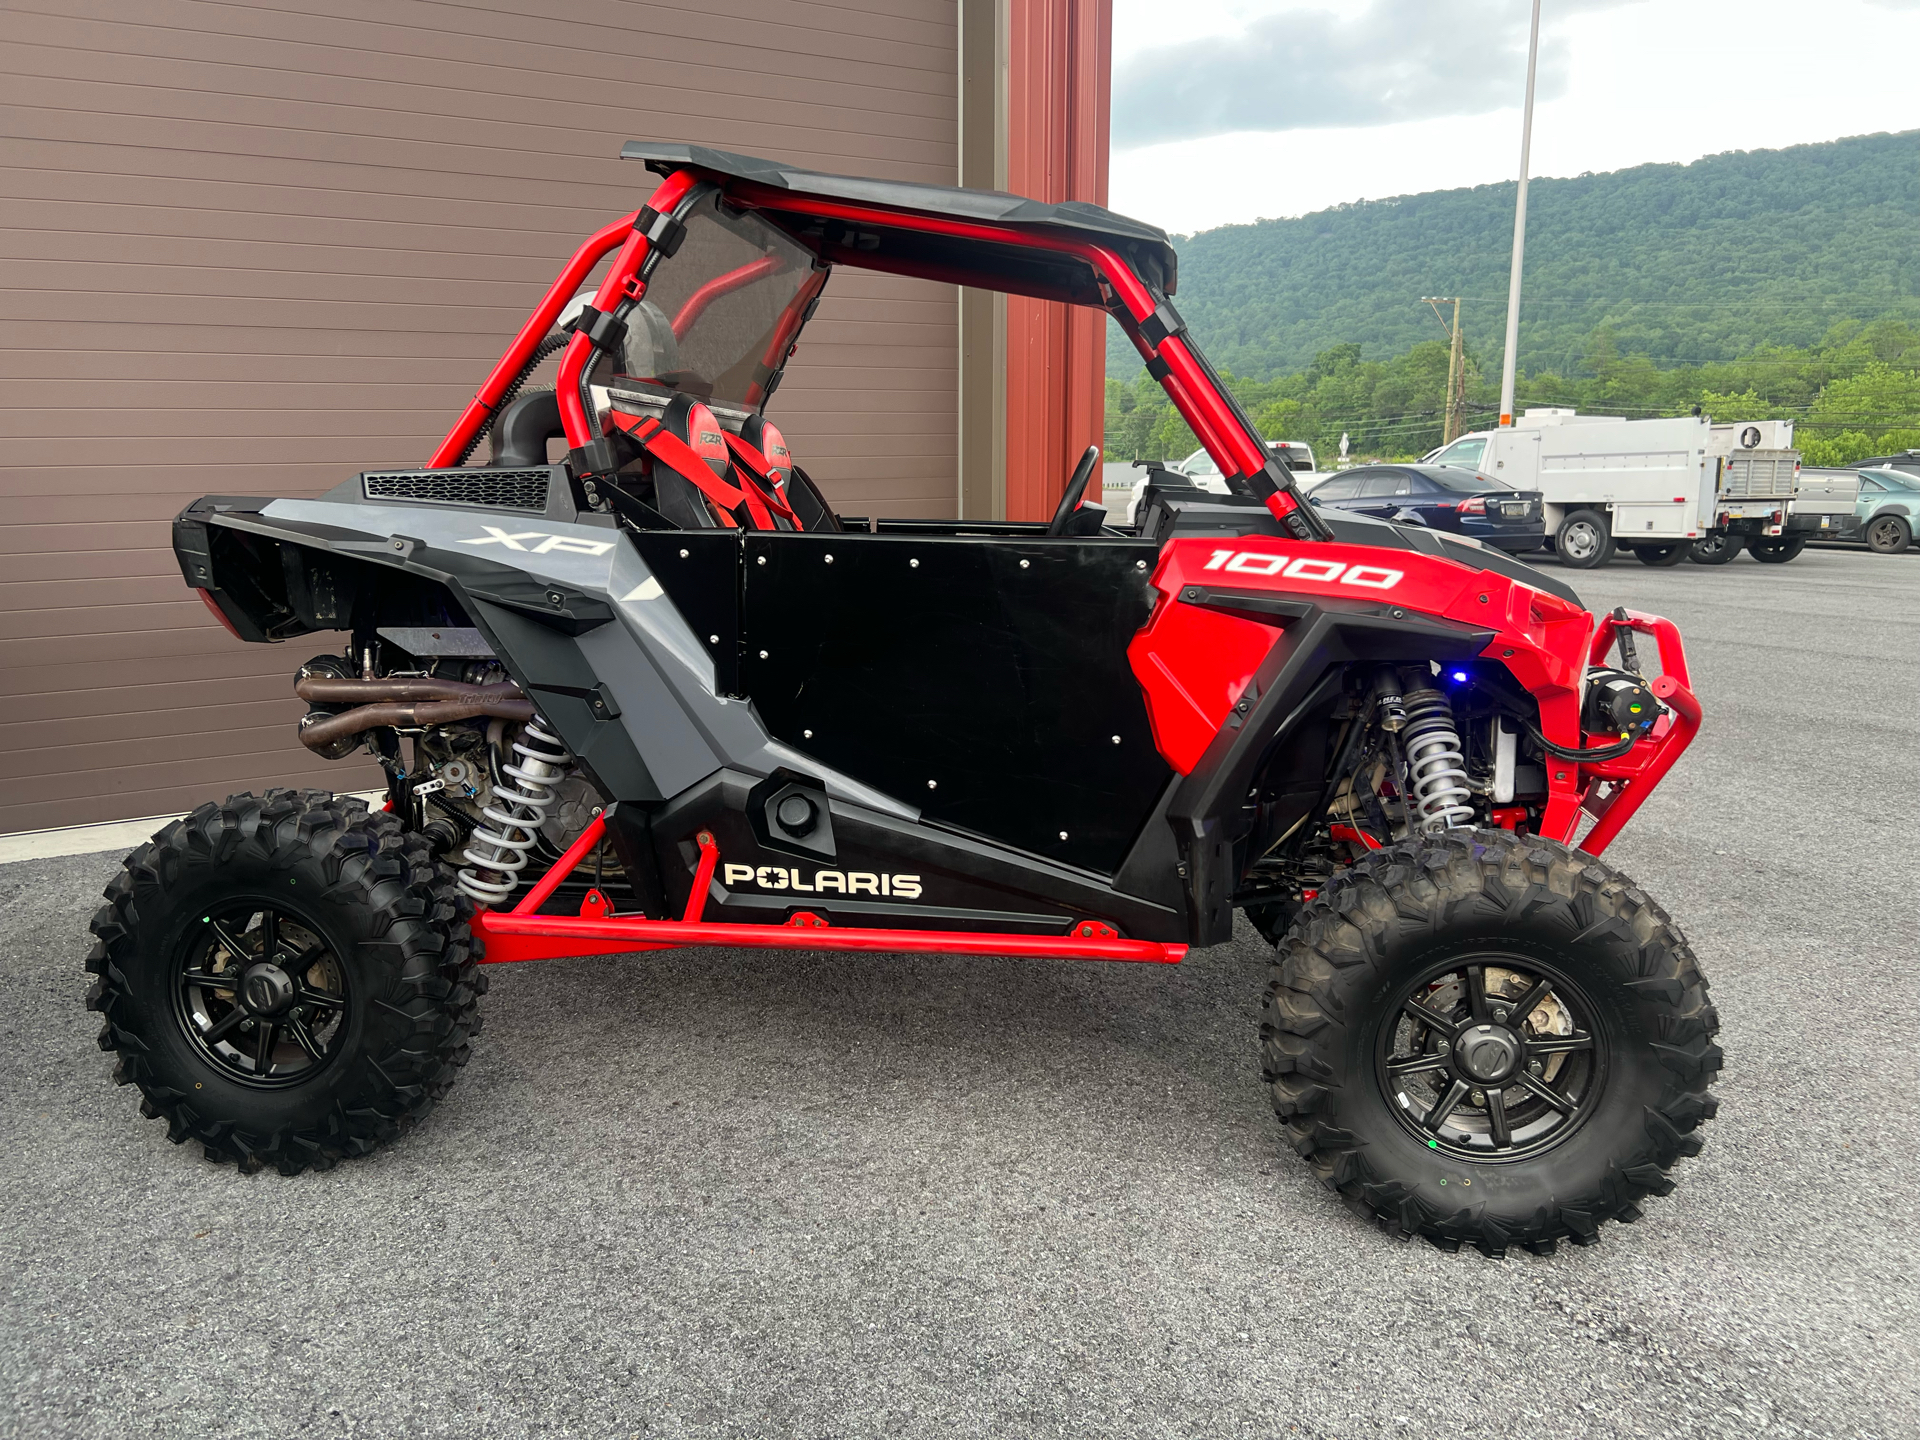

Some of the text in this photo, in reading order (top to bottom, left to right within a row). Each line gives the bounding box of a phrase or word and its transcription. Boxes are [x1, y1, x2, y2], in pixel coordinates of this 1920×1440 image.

[699, 431, 722, 446] RZR
[454, 525, 617, 556] XP
[1203, 550, 1405, 590] 1000
[724, 863, 923, 899] POLARIS
